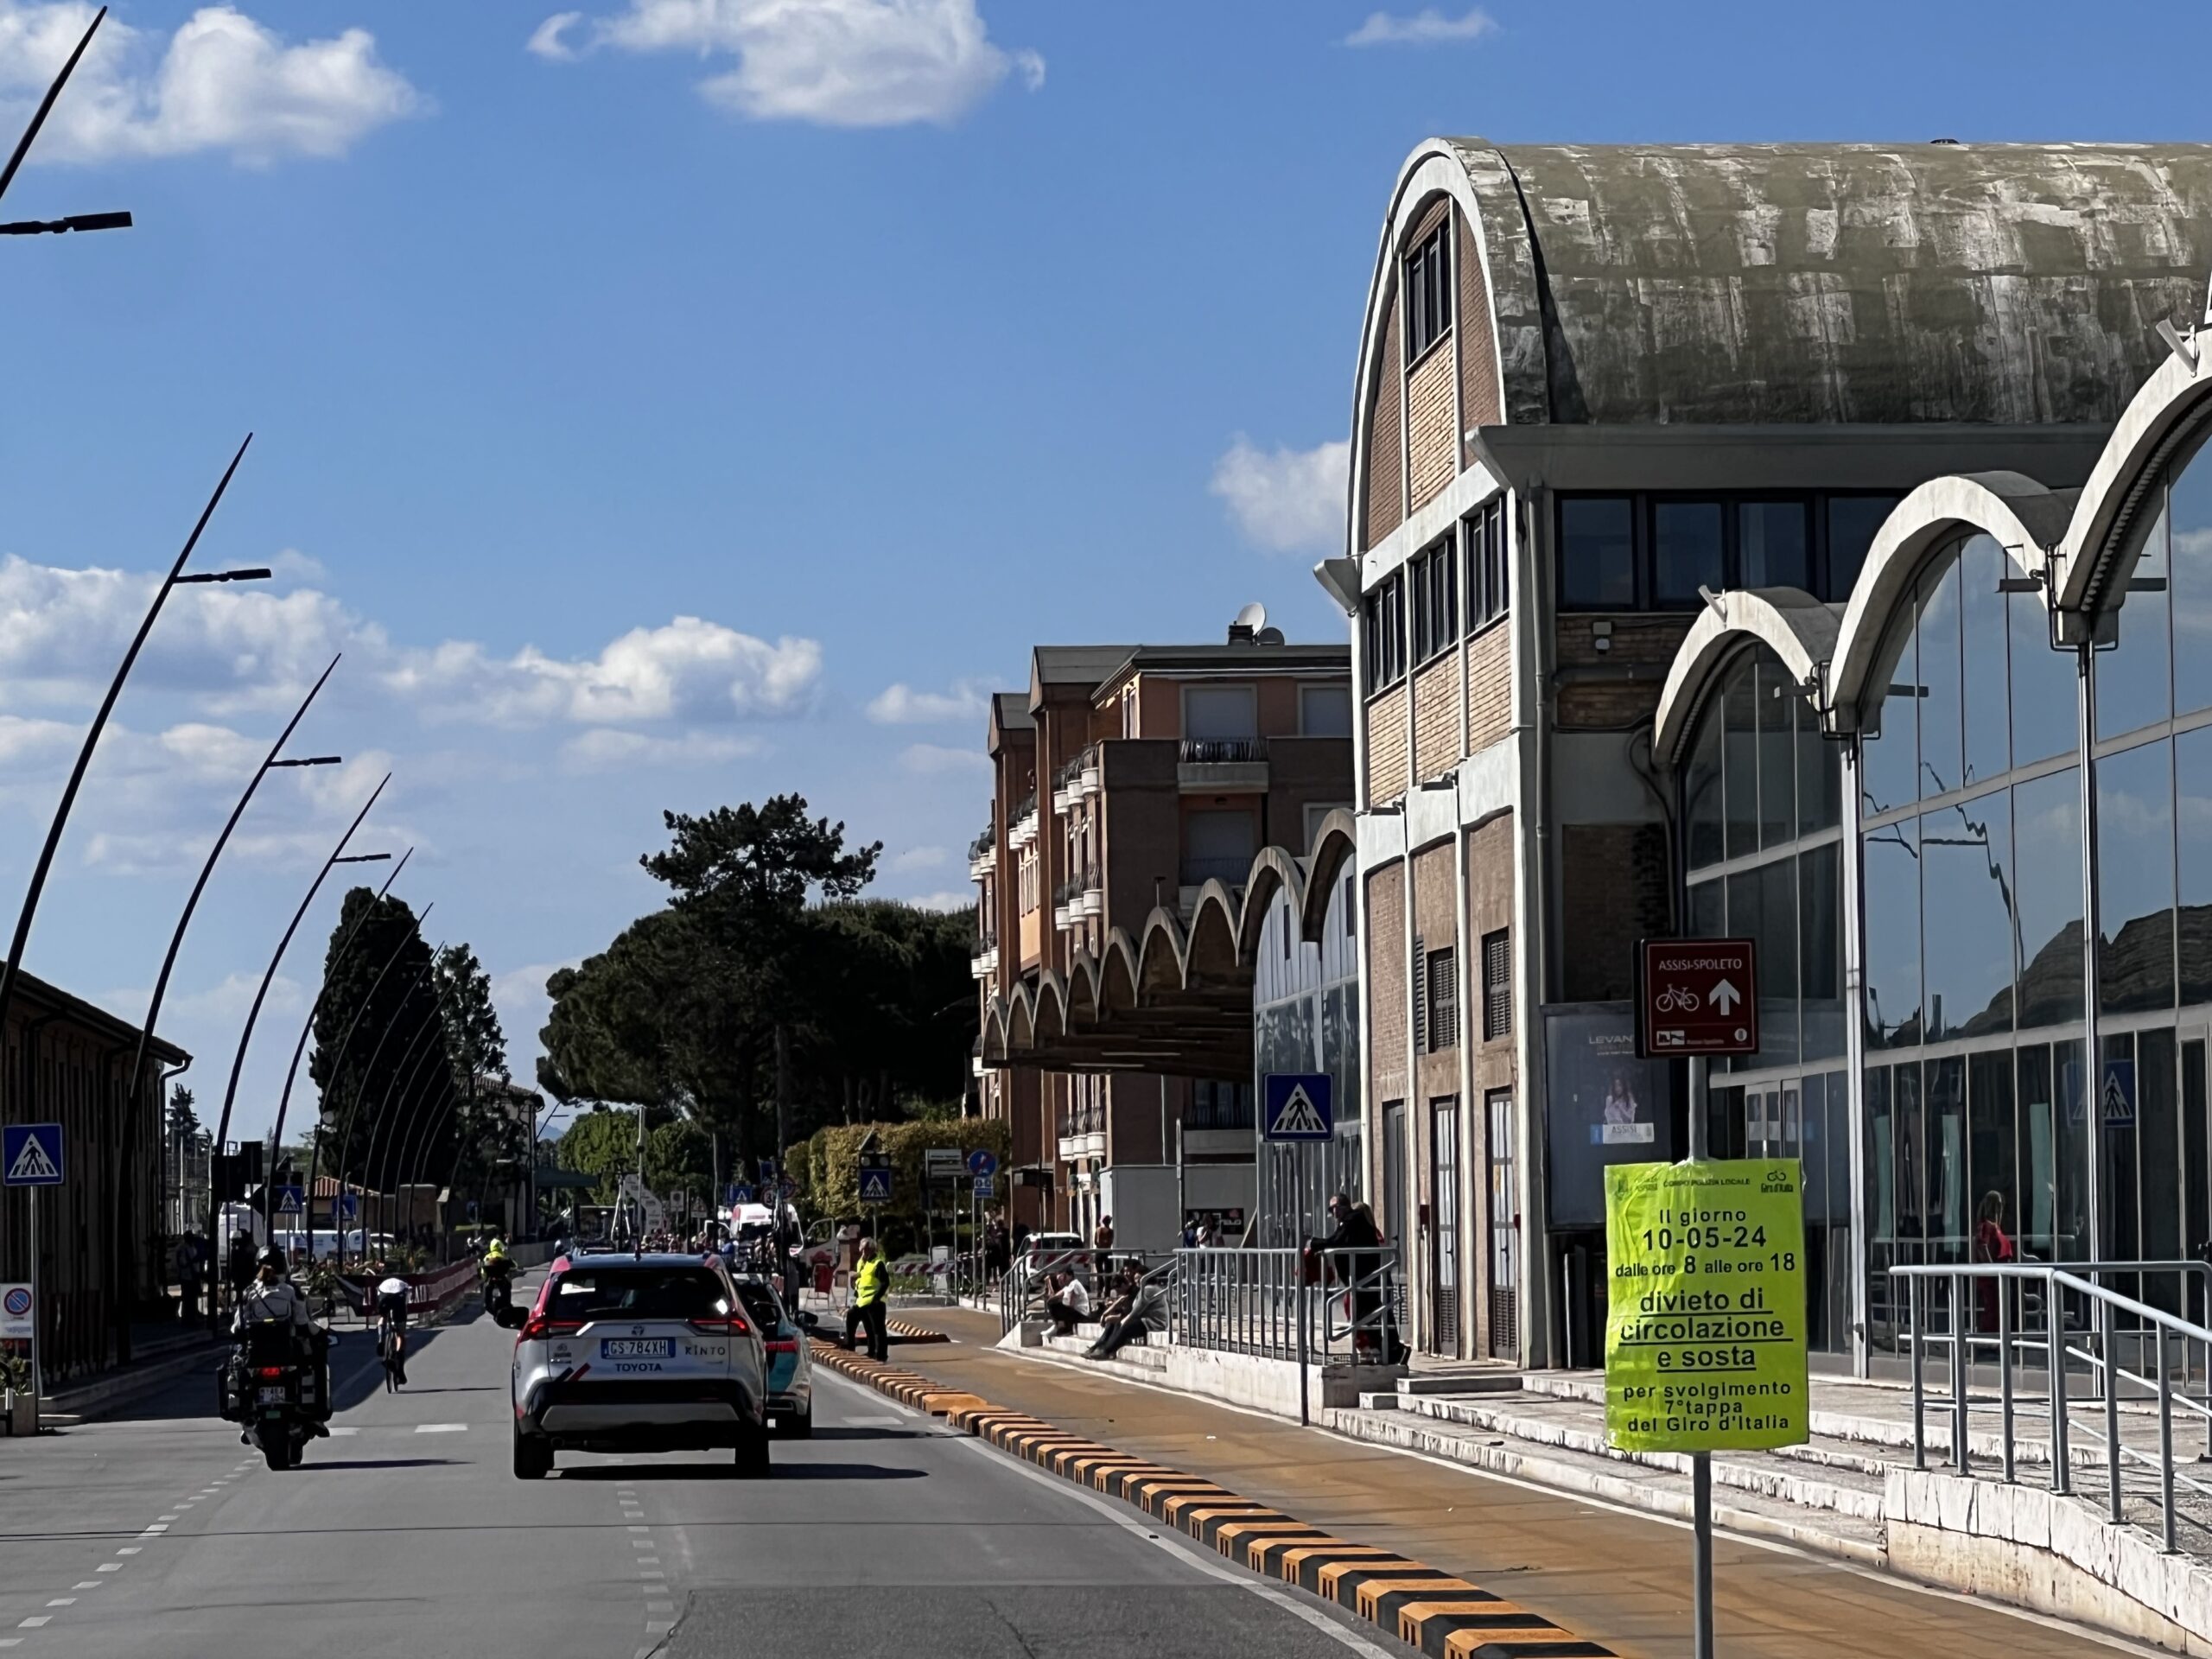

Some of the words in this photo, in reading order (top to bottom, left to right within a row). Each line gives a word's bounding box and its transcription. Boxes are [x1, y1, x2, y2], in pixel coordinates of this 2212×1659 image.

[1658, 958, 1742, 971] ASSISI-SPOLETO
[1588, 1035, 1634, 1045] LEVAN
[1659, 1209, 1671, 1224] Il
[1681, 1208, 1746, 1227] giorno
[1643, 1226, 1766, 1250] 10-05-24
[1616, 1262, 1649, 1278] dalle
[1652, 1264, 1675, 1276] ore
[1684, 1255, 1696, 1274] 8
[1704, 1259, 1732, 1274] alle
[1737, 1260, 1764, 1273] ore
[1770, 1253, 1796, 1272] 18
[1640, 1288, 1730, 1313] divieto
[1740, 1287, 1764, 1310] di
[1620, 1317, 1784, 1341] circolazione
[1657, 1351, 1672, 1368] e
[1681, 1345, 1756, 1367] sosta
[615, 1363, 663, 1372] TOYOTA
[1624, 1385, 1655, 1402] per
[1664, 1382, 1791, 1401] svolgimento
[1628, 1417, 1657, 1433] del
[1667, 1415, 1709, 1432] Giro
[1719, 1414, 1789, 1431] d'Italia
